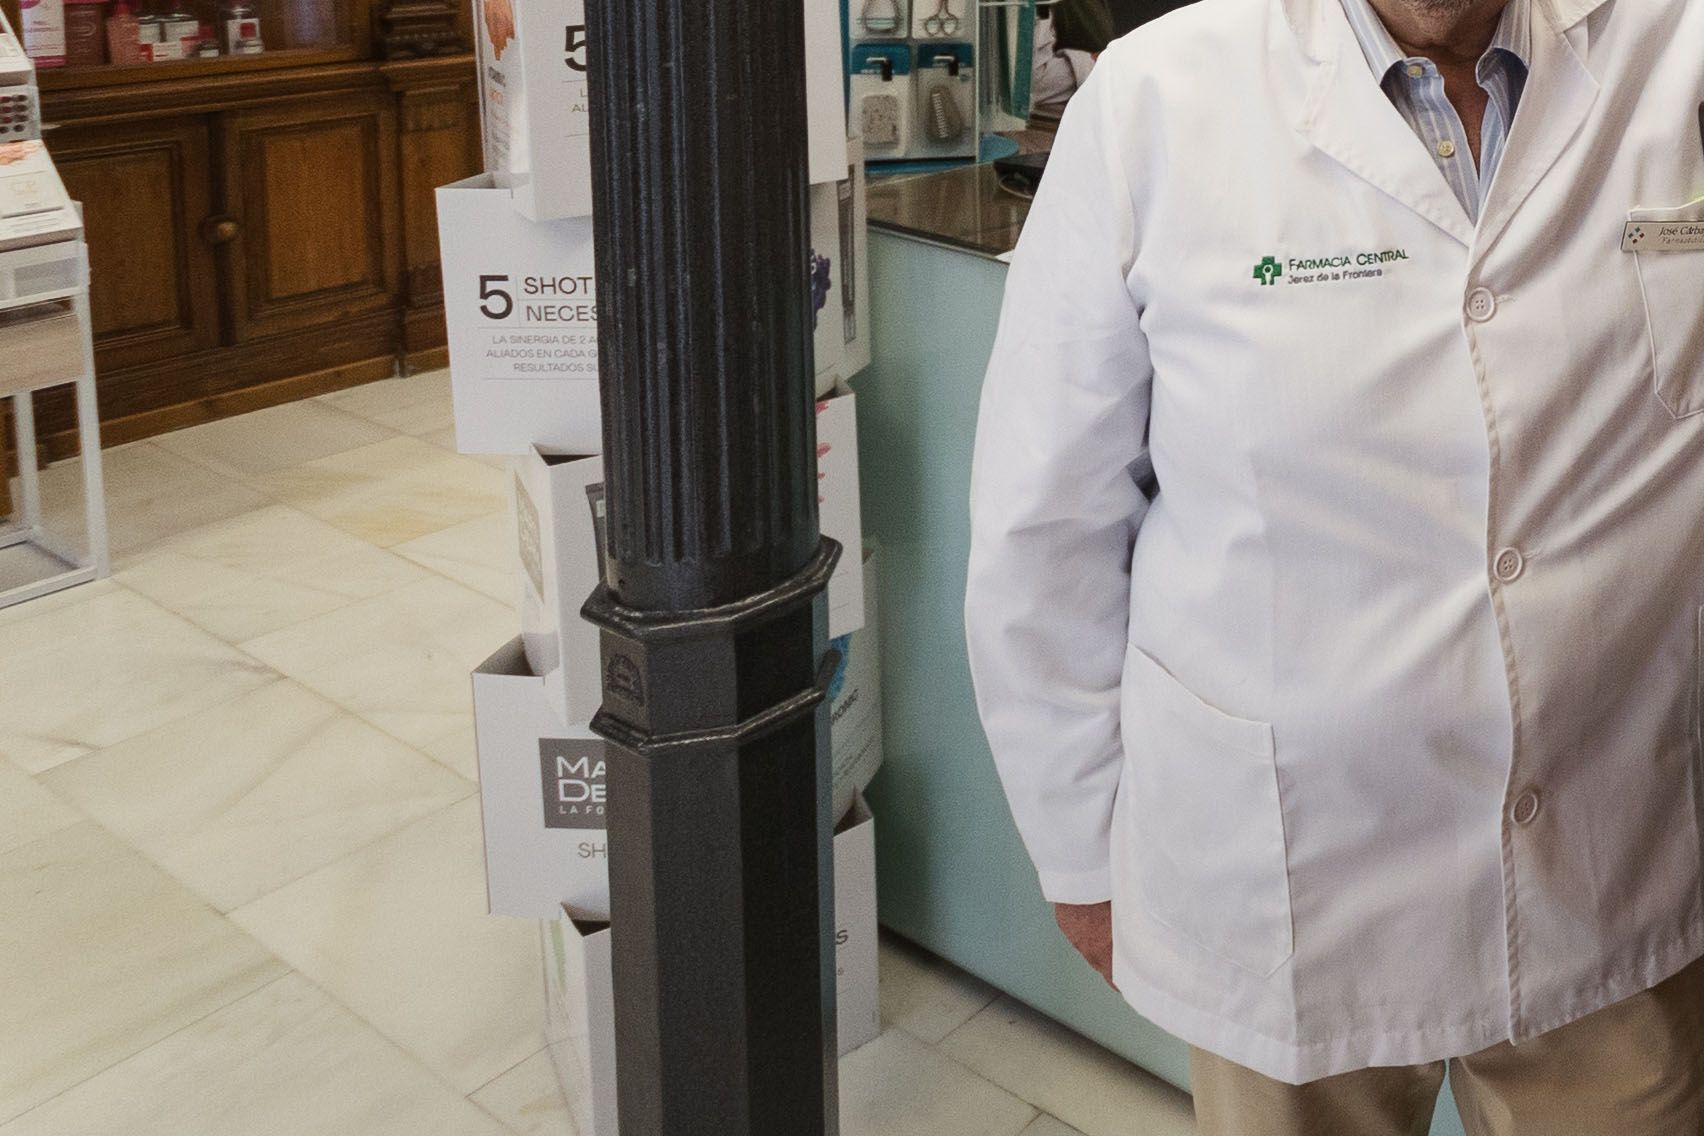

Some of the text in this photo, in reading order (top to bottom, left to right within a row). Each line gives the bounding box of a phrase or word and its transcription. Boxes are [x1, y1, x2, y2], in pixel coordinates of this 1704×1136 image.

[564, 24, 587, 72] 5
[1288, 249, 1409, 272] FARMACIA CENTRAL
[524, 276, 593, 295] SHOT
[1288, 268, 1383, 285] Jerez de la Frontera
[479, 275, 513, 320] 5
[492, 335, 507, 344] LA
[510, 335, 559, 344] SINERGIA
[562, 335, 576, 344] DE
[486, 349, 534, 358] ALIADOS
[536, 349, 552, 358] EN
[554, 349, 585, 358] CADA
[513, 363, 584, 372] RESULTADOS
[556, 756, 606, 778] MA
[558, 779, 607, 803] DE
[559, 805, 604, 815] LA FO
